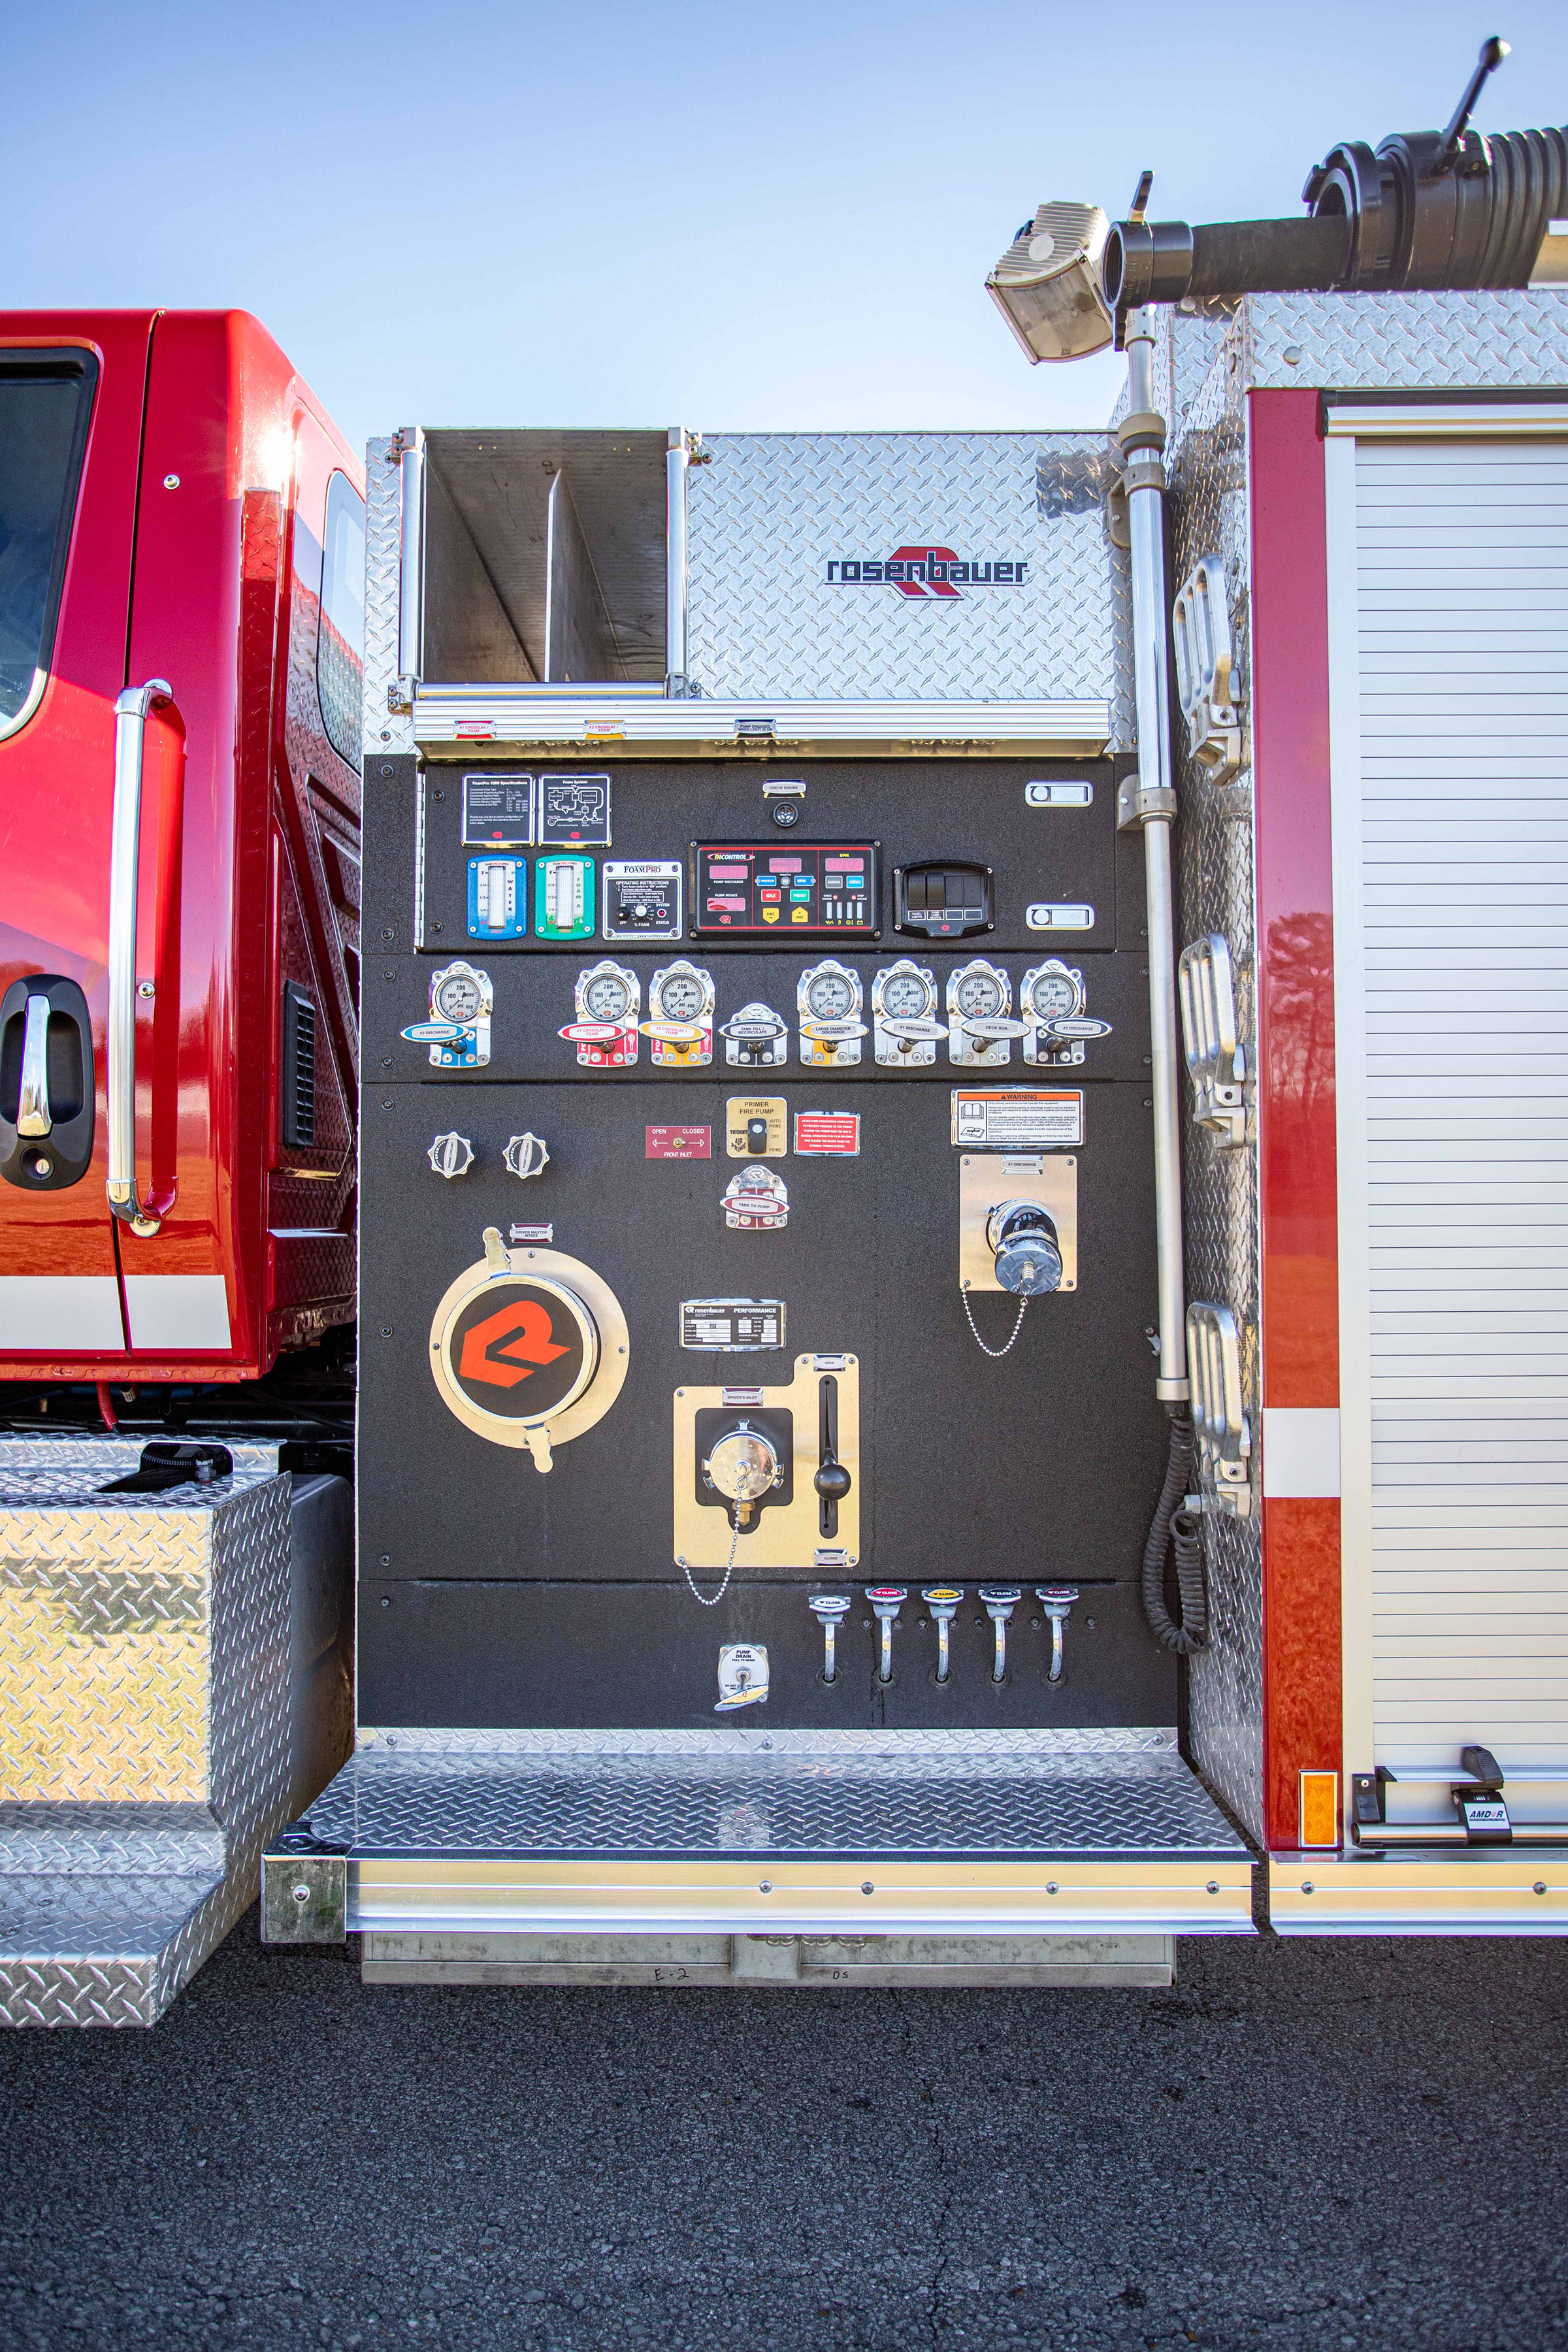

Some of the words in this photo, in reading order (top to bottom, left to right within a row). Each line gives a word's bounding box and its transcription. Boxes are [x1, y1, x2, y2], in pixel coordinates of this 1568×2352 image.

[827, 551, 1028, 583] rosenbauer
[731, 1142, 746, 1152] PRIME
[654, 1968, 690, 1981] E-2
